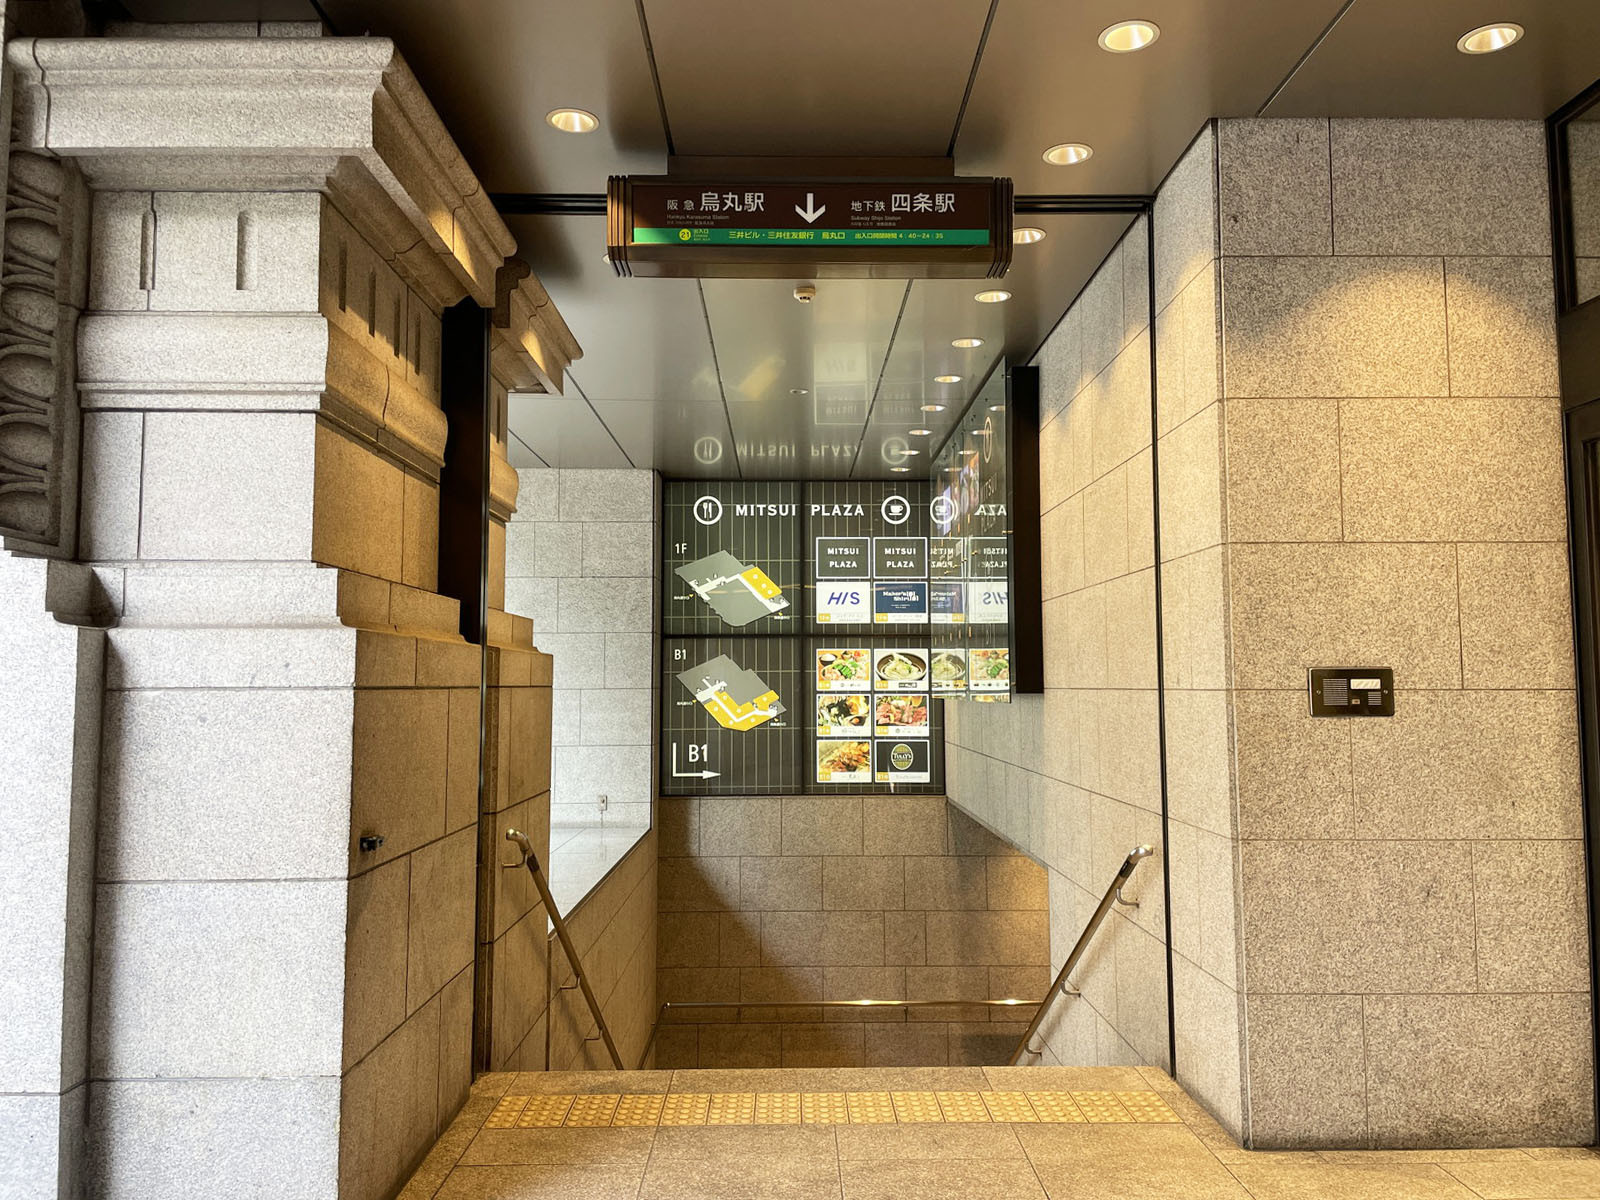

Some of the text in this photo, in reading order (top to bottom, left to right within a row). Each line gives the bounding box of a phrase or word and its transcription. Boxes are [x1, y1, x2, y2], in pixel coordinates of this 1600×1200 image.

[666, 191, 765, 212] 阪急 烏丸駅
[850, 193, 956, 213] 地下鉄 四条駅
[735, 504, 865, 517] MITSUI PLAZA
[674, 543, 688, 554] 1F
[827, 547, 860, 555] MITSUI
[884, 547, 917, 555] MITSUI
[829, 560, 858, 568] PLAZA
[886, 560, 915, 568] PLAZA
[674, 649, 687, 660] B1
[688, 744, 708, 763] B1
